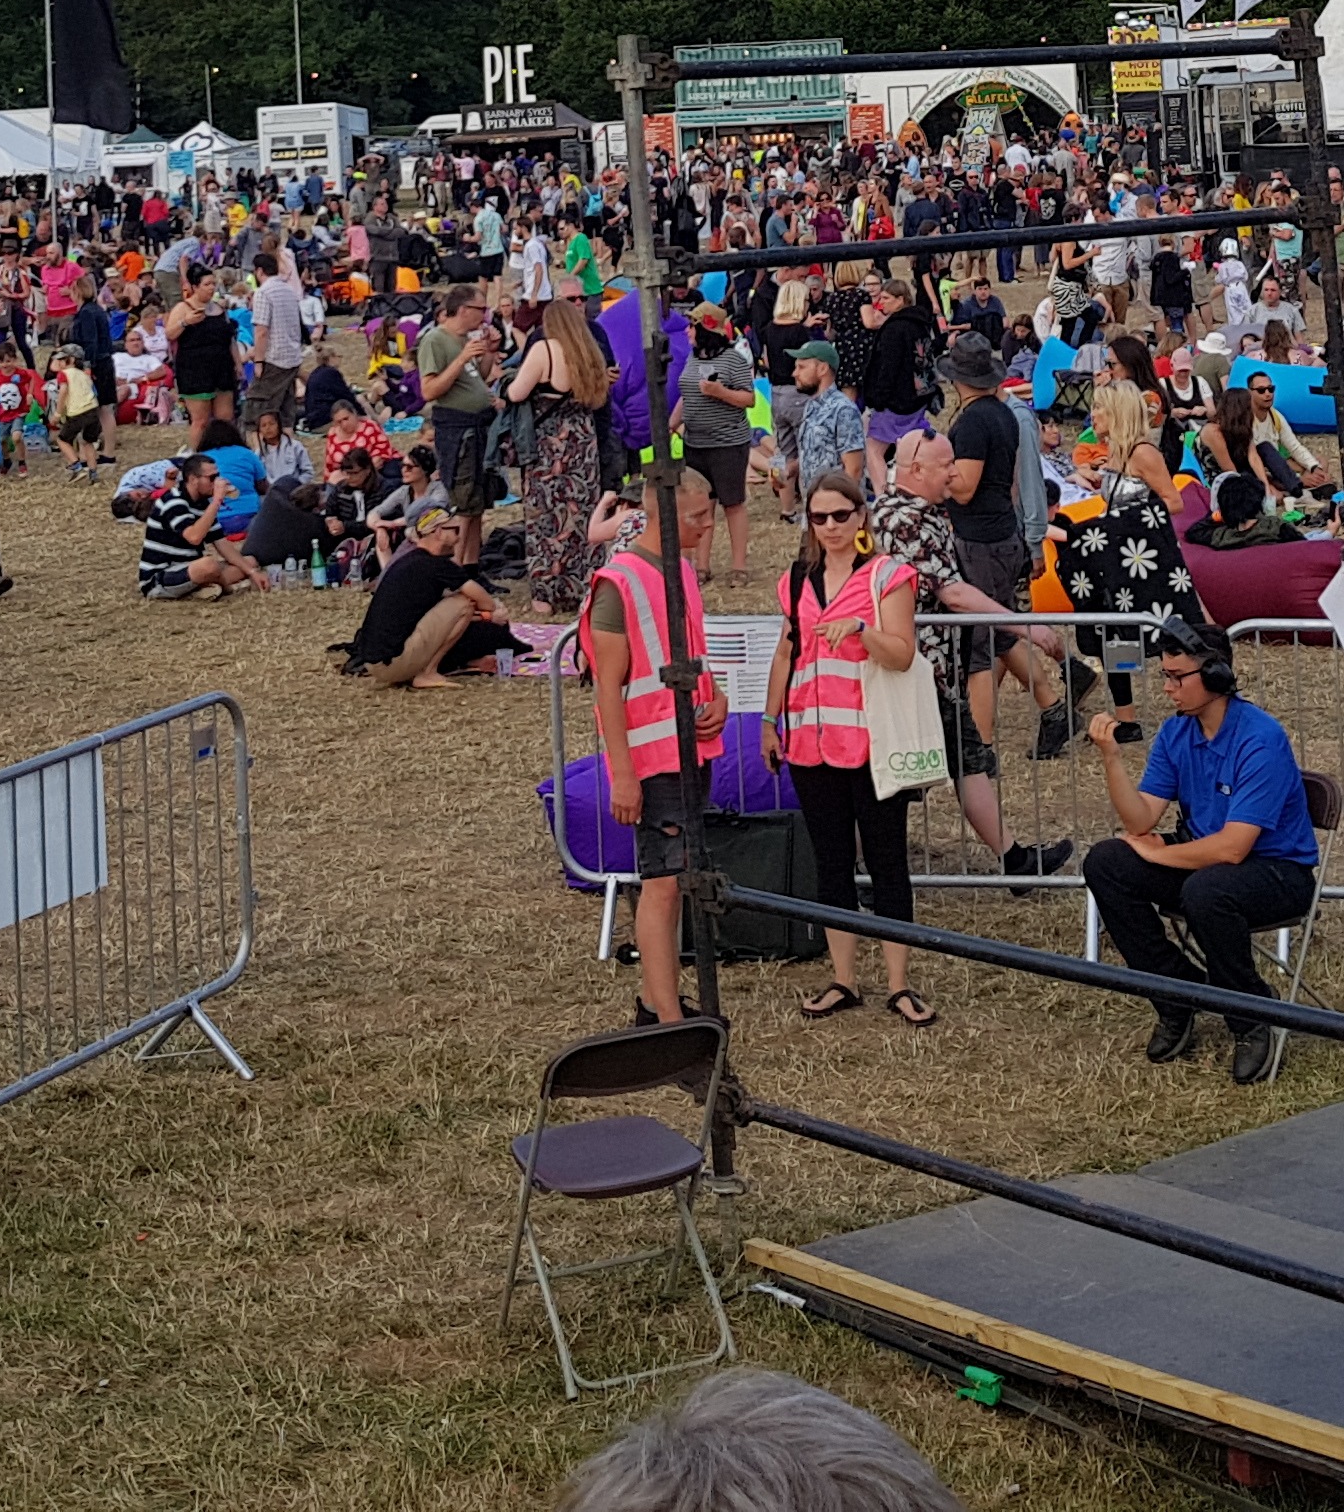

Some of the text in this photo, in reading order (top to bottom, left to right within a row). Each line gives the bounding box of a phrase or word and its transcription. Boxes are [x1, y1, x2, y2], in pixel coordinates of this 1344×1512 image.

[483, 43, 537, 106] PIE
[485, 117, 554, 130] PIE MAKER
